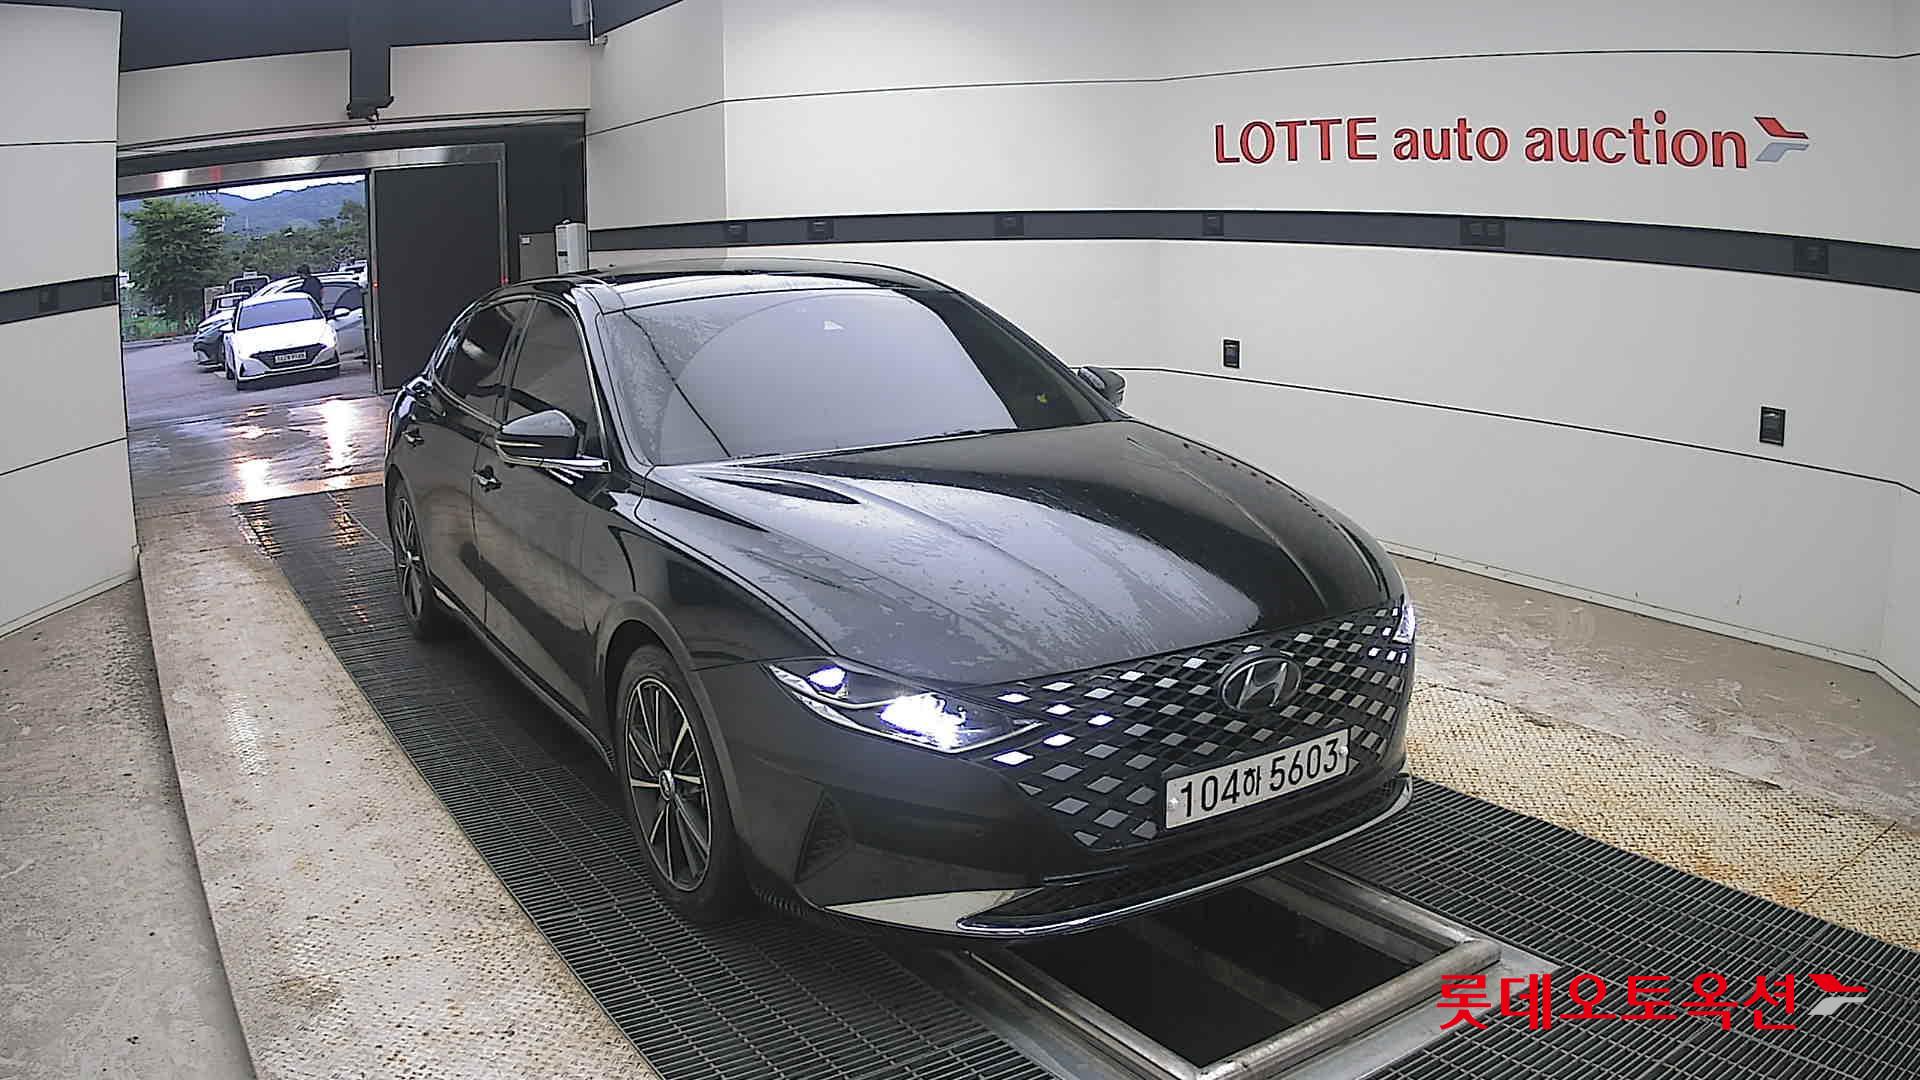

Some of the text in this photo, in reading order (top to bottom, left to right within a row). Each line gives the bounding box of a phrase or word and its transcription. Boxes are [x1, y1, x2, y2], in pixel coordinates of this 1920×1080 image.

[1214, 110, 1748, 169] LOTTE auto auction
[1180, 737, 1339, 818] 104하 5603
